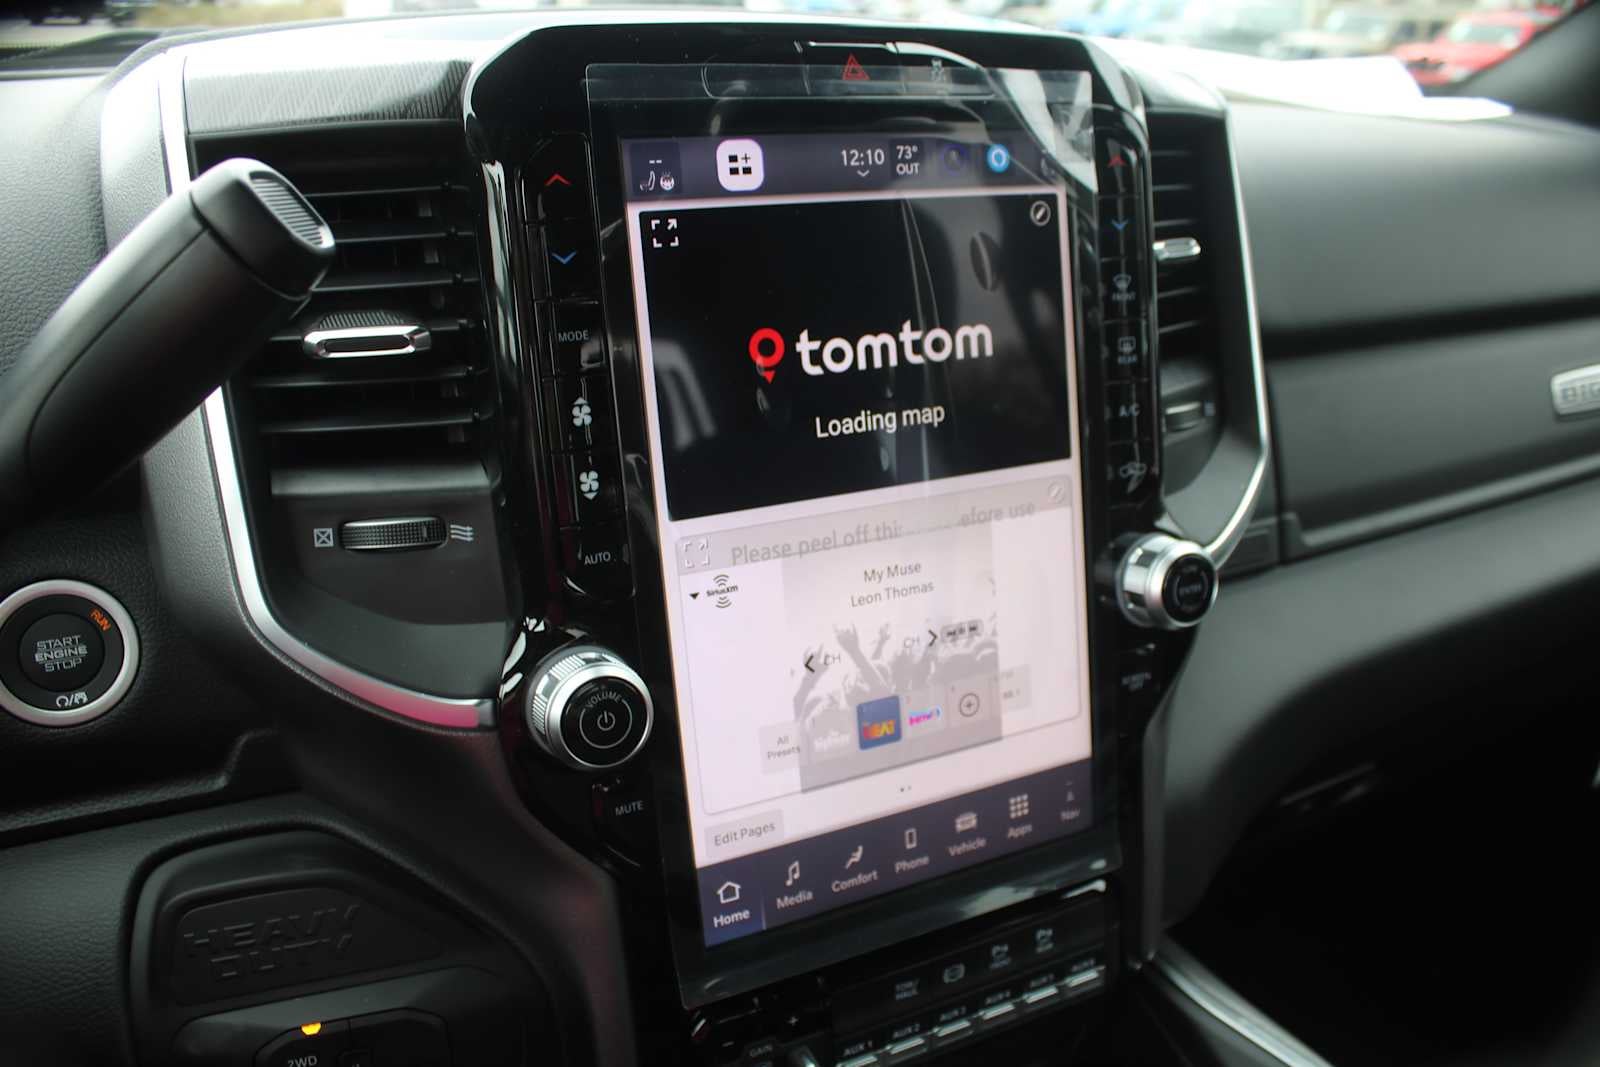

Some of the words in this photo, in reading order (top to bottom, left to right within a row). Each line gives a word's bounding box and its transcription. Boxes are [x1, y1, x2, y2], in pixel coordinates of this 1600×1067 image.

[841, 148, 885, 166] 12:10
[896, 145, 919, 160] 73°
[896, 162, 920, 175] OUT
[558, 329, 589, 342] MODE
[795, 319, 994, 376] tomtom
[815, 409, 897, 438] Loading
[902, 405, 945, 428] map
[731, 543, 792, 566] Please
[799, 529, 837, 558] peel
[843, 523, 869, 547] off
[1008, 502, 1035, 518] use
[584, 551, 611, 566] AUTO
[864, 569, 883, 583] My
[887, 563, 921, 578] Muse
[851, 592, 882, 607] Leon
[885, 582, 935, 600] Thomas
[88, 607, 112, 632] RUN
[36, 635, 81, 651] START
[903, 636, 920, 648] CH
[35, 645, 88, 662] ENGINE
[45, 657, 82, 673] STOP
[585, 690, 622, 708] VOLUME
[776, 735, 790, 746] All
[767, 746, 800, 759] Presets
[615, 800, 645, 816] MUTE
[714, 832, 738, 847] Edit
[740, 823, 776, 841] Pages
[1007, 824, 1033, 840] Apps
[948, 837, 987, 857] Vehicle
[894, 856, 930, 873] Phone
[831, 870, 878, 892] Comfort
[776, 891, 814, 909] Media
[713, 910, 751, 928] Home
[182, 904, 361, 956] HEAVY
[208, 934, 352, 983] DUTY
[892, 1025, 913, 1039] AUX
[843, 1042, 865, 1056] AUX
